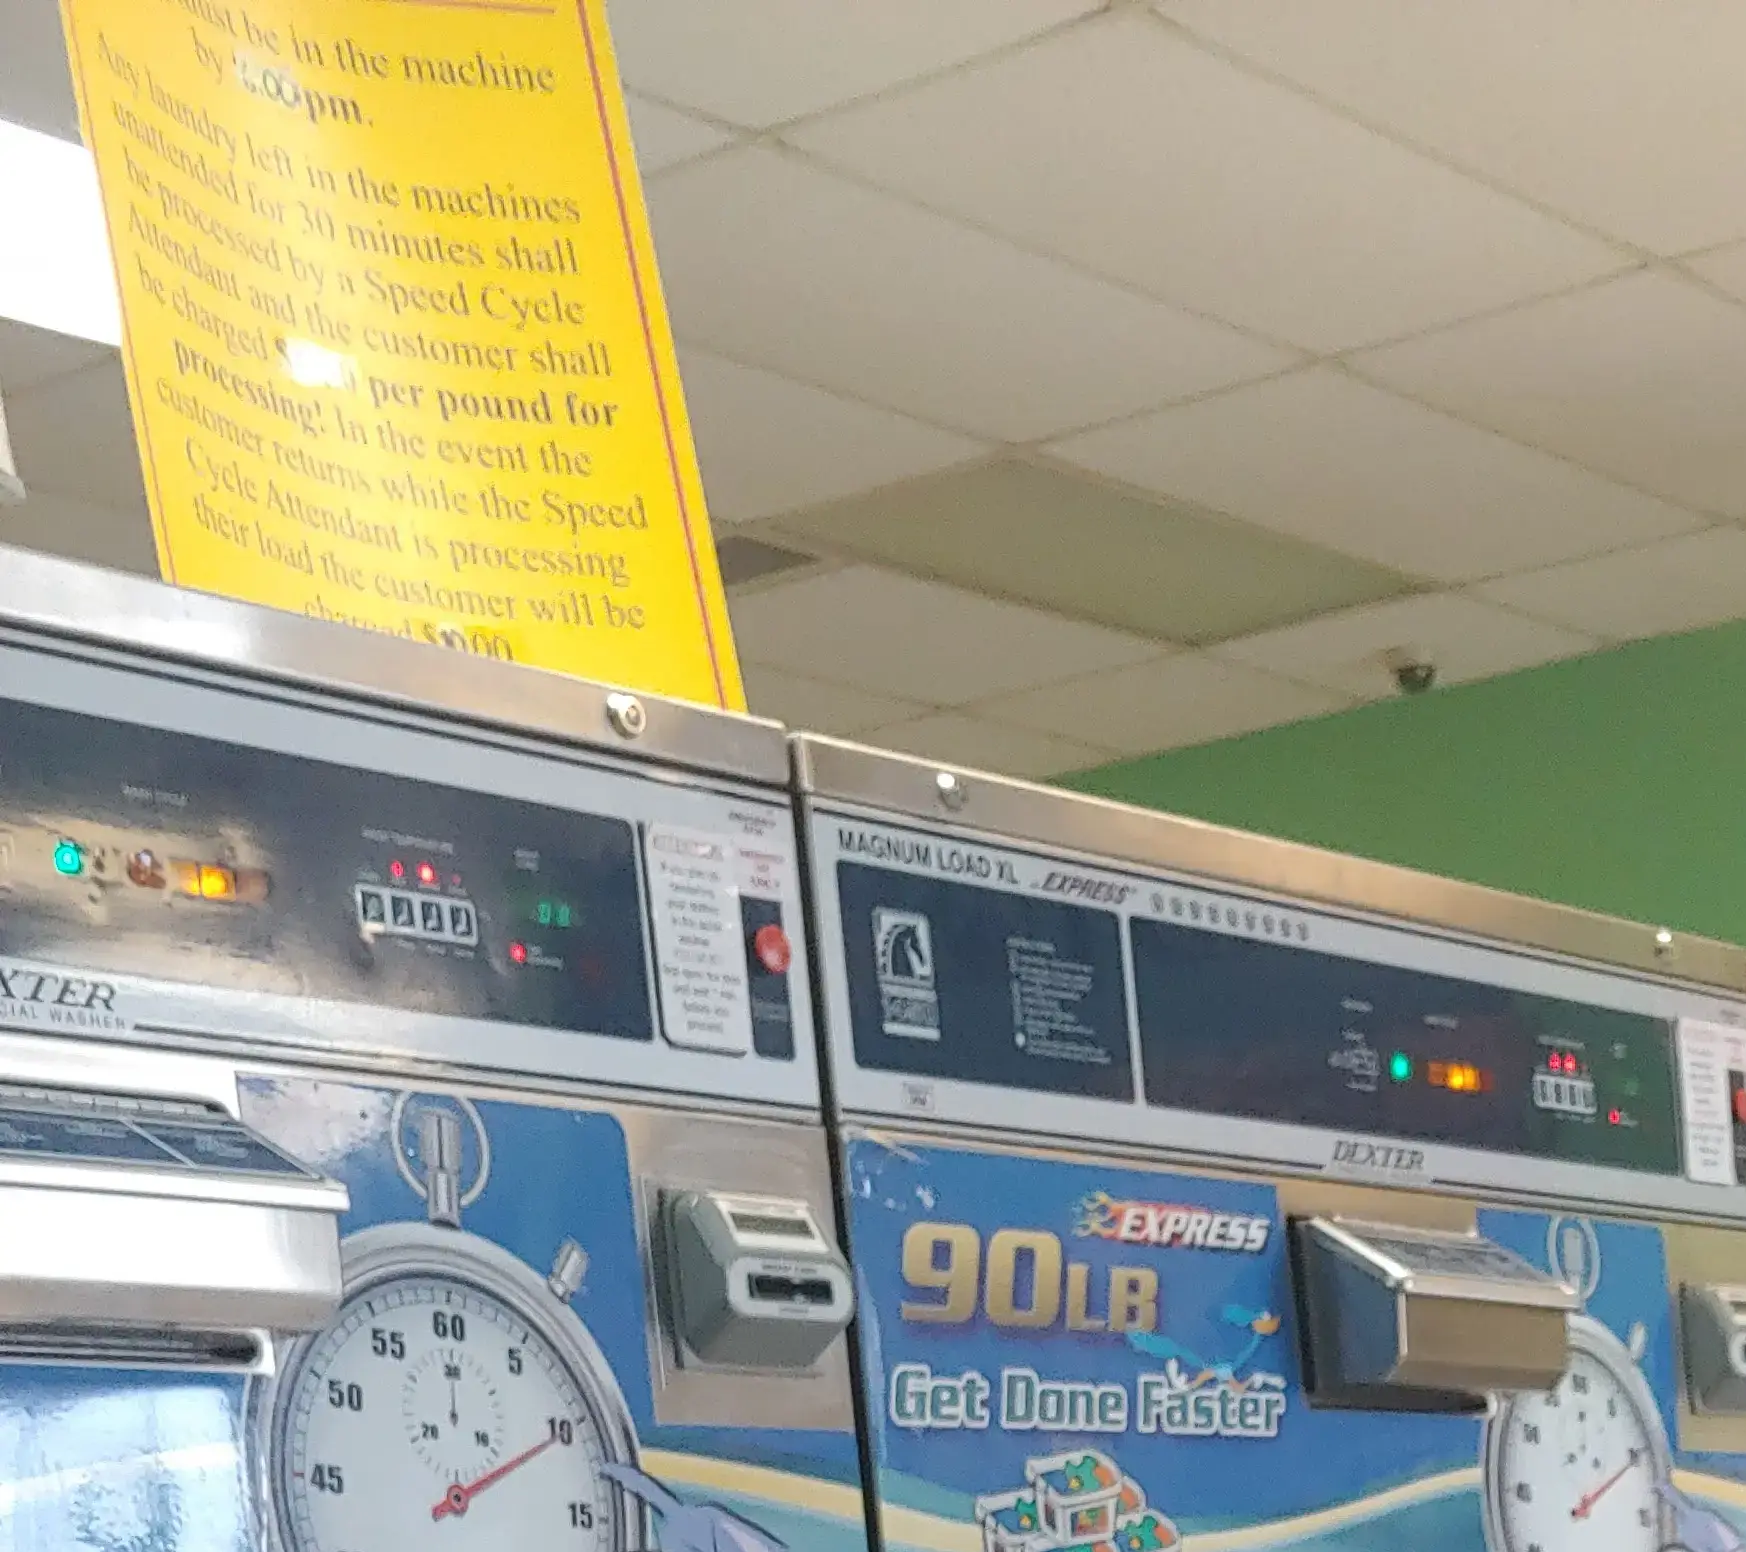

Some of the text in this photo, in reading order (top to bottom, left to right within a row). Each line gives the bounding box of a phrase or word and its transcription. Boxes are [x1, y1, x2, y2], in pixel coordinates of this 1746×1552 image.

[190, 25, 223, 85] by
[242, 9, 280, 55] be
[289, 21, 325, 67] in
[334, 37, 390, 79] the
[402, 50, 556, 95] machine
[144, 64, 236, 165] laundry
[245, 132, 294, 180] left
[305, 154, 337, 193] in
[348, 167, 399, 208] the
[411, 182, 581, 223] machines
[112, 100, 240, 204] unattended
[247, 180, 286, 224] for
[346, 219, 486, 267] minutes
[495, 236, 581, 276] shall
[123, 144, 152, 197] be
[158, 181, 283, 273] processed
[286, 244, 325, 297] by
[364, 268, 471, 315] Speed
[480, 281, 587, 331] Cycle
[129, 201, 242, 302] Attendant
[248, 285, 298, 328] and
[305, 301, 352, 346] the
[362, 325, 519, 373] customer
[528, 340, 614, 378] shall
[135, 251, 621, 427] be charged per pound for
[173, 338, 327, 438] processing!
[334, 403, 369, 446] In
[377, 420, 428, 460] the
[436, 440, 531, 474] event
[539, 439, 593, 478] the
[156, 376, 650, 536] customer returns while the Speed
[185, 435, 631, 588] Cycle Attendant is processing
[193, 493, 250, 548] their
[255, 521, 315, 577] load
[319, 550, 367, 592] the
[374, 571, 518, 621] customer
[527, 589, 597, 627] will
[600, 593, 647, 631] be
[838, 829, 934, 869] MAGNUM
[938, 849, 993, 881] LOAD
[1040, 871, 1130, 905] EXPRESS
[1332, 1140, 1426, 1171] DEXTER
[1115, 1205, 1271, 1254] EXPRESS
[371, 1326, 405, 1361] 55
[433, 1310, 466, 1343] 60
[507, 1346, 524, 1376] 5
[327, 1378, 364, 1413] 50
[547, 1416, 574, 1447] 10
[891, 1363, 1286, 1438] Get Done Faster
[310, 1463, 345, 1495] 45
[568, 1501, 594, 1530] 15
